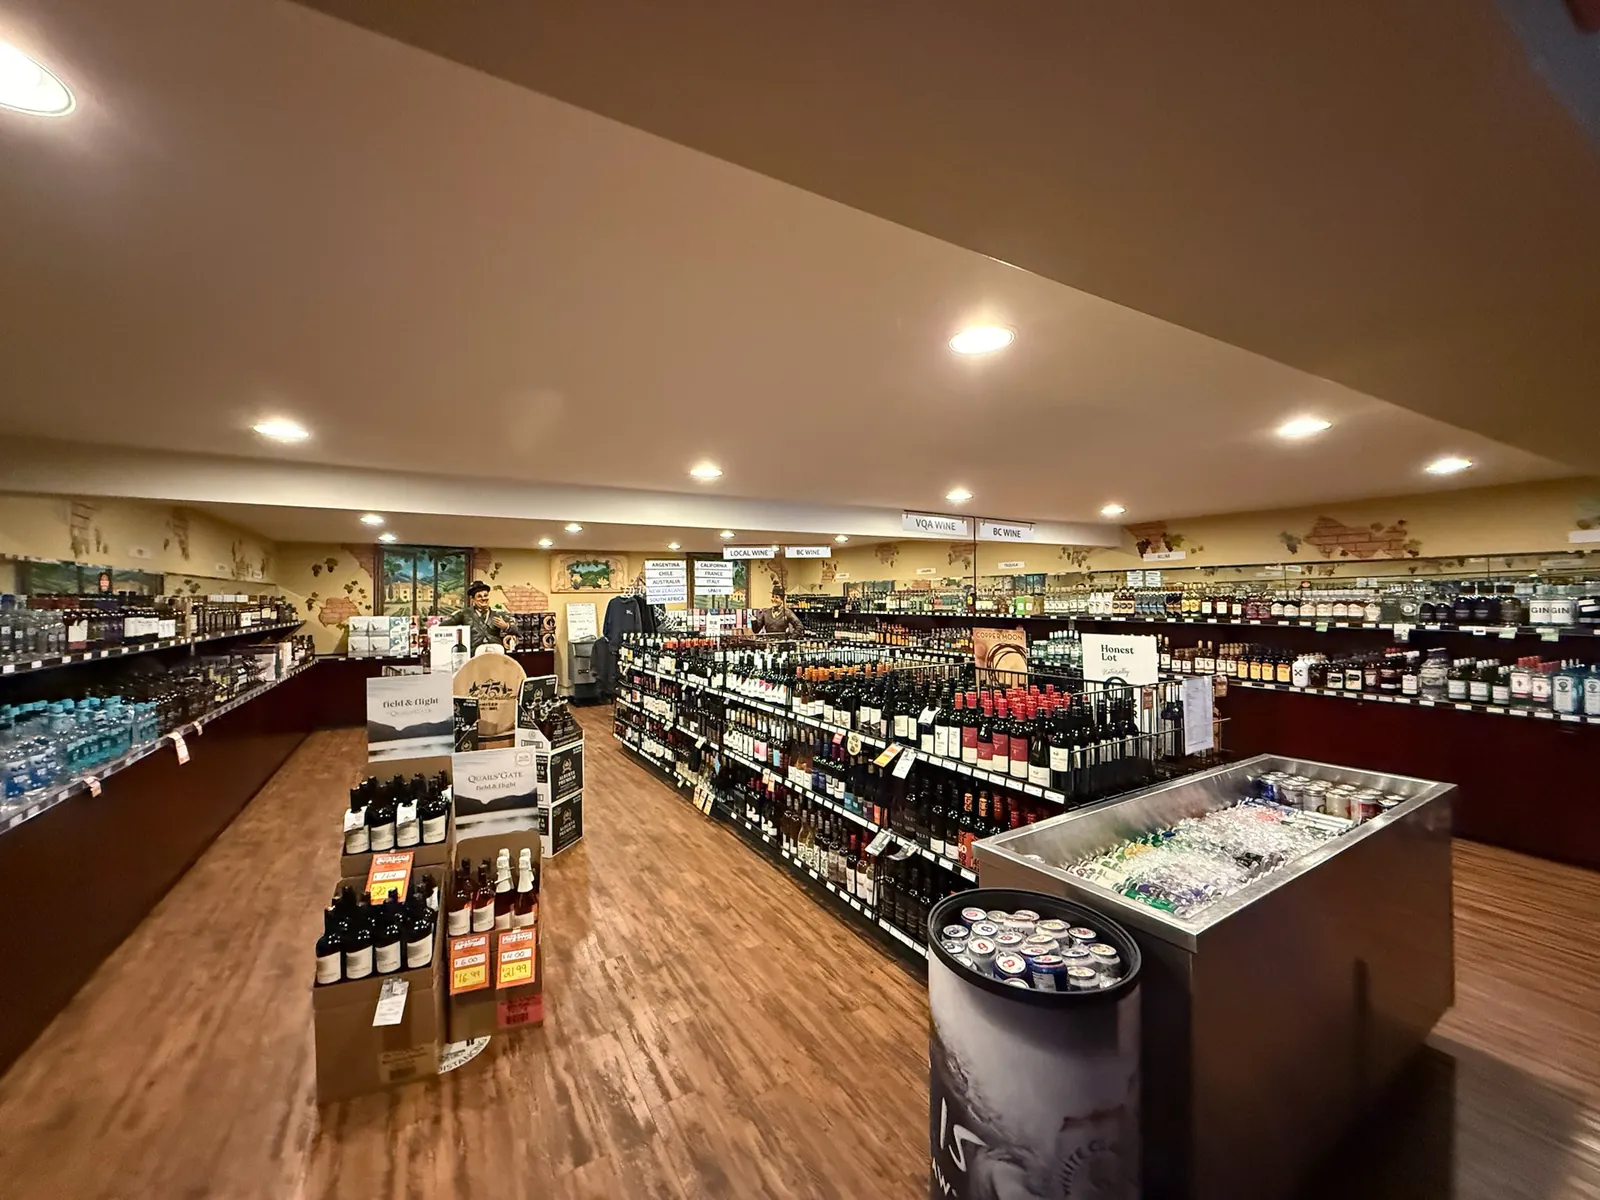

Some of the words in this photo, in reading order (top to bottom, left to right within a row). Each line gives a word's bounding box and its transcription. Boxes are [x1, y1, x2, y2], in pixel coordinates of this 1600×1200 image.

[915, 518, 933, 530] VQA
[934, 521, 957, 531] WINE
[992, 527, 1003, 537] BC
[1003, 528, 1022, 538] WINE
[975, 631, 1000, 639] COPPER
[1101, 644, 1134, 655] Honest
[1101, 652, 1117, 661] Lot
[481, 681, 501, 695] 75
[383, 699, 404, 708] field
[414, 697, 438, 706] flight
